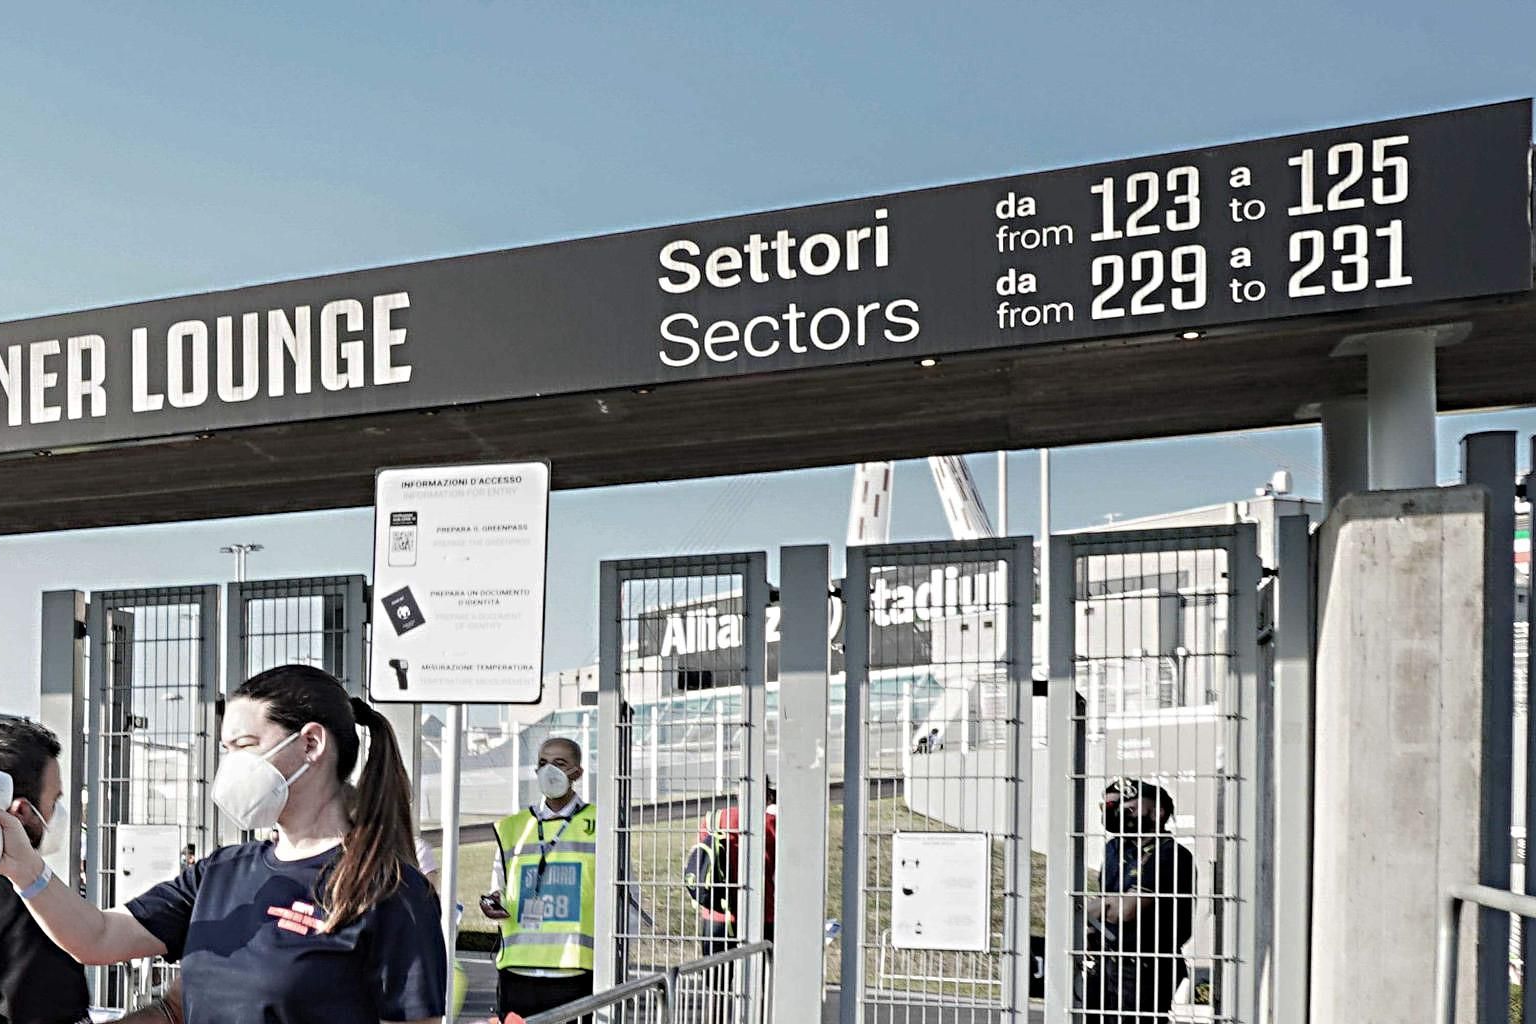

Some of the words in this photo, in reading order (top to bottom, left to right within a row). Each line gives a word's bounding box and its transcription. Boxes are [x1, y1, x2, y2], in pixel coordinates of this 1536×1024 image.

[995, 192, 1036, 219] da
[1090, 165, 1200, 242] 123
[1229, 166, 1251, 188] a
[1288, 135, 1409, 216] 125
[1229, 198, 1266, 223] to
[658, 208, 889, 294] Settori
[995, 224, 1073, 253] from
[995, 268, 1037, 296] da
[1091, 244, 1207, 321] 229
[1230, 246, 1252, 268] a
[1288, 219, 1413, 298] 231
[1229, 278, 1266, 303] to
[659, 298, 920, 367] Sectors
[996, 300, 1074, 329] from
[131, 291, 412, 413] LOUNGE
[402, 479, 467, 488] INFORMAZIONI
[661, 604, 781, 657] Alliaz
[525, 866, 577, 889] STWARD
